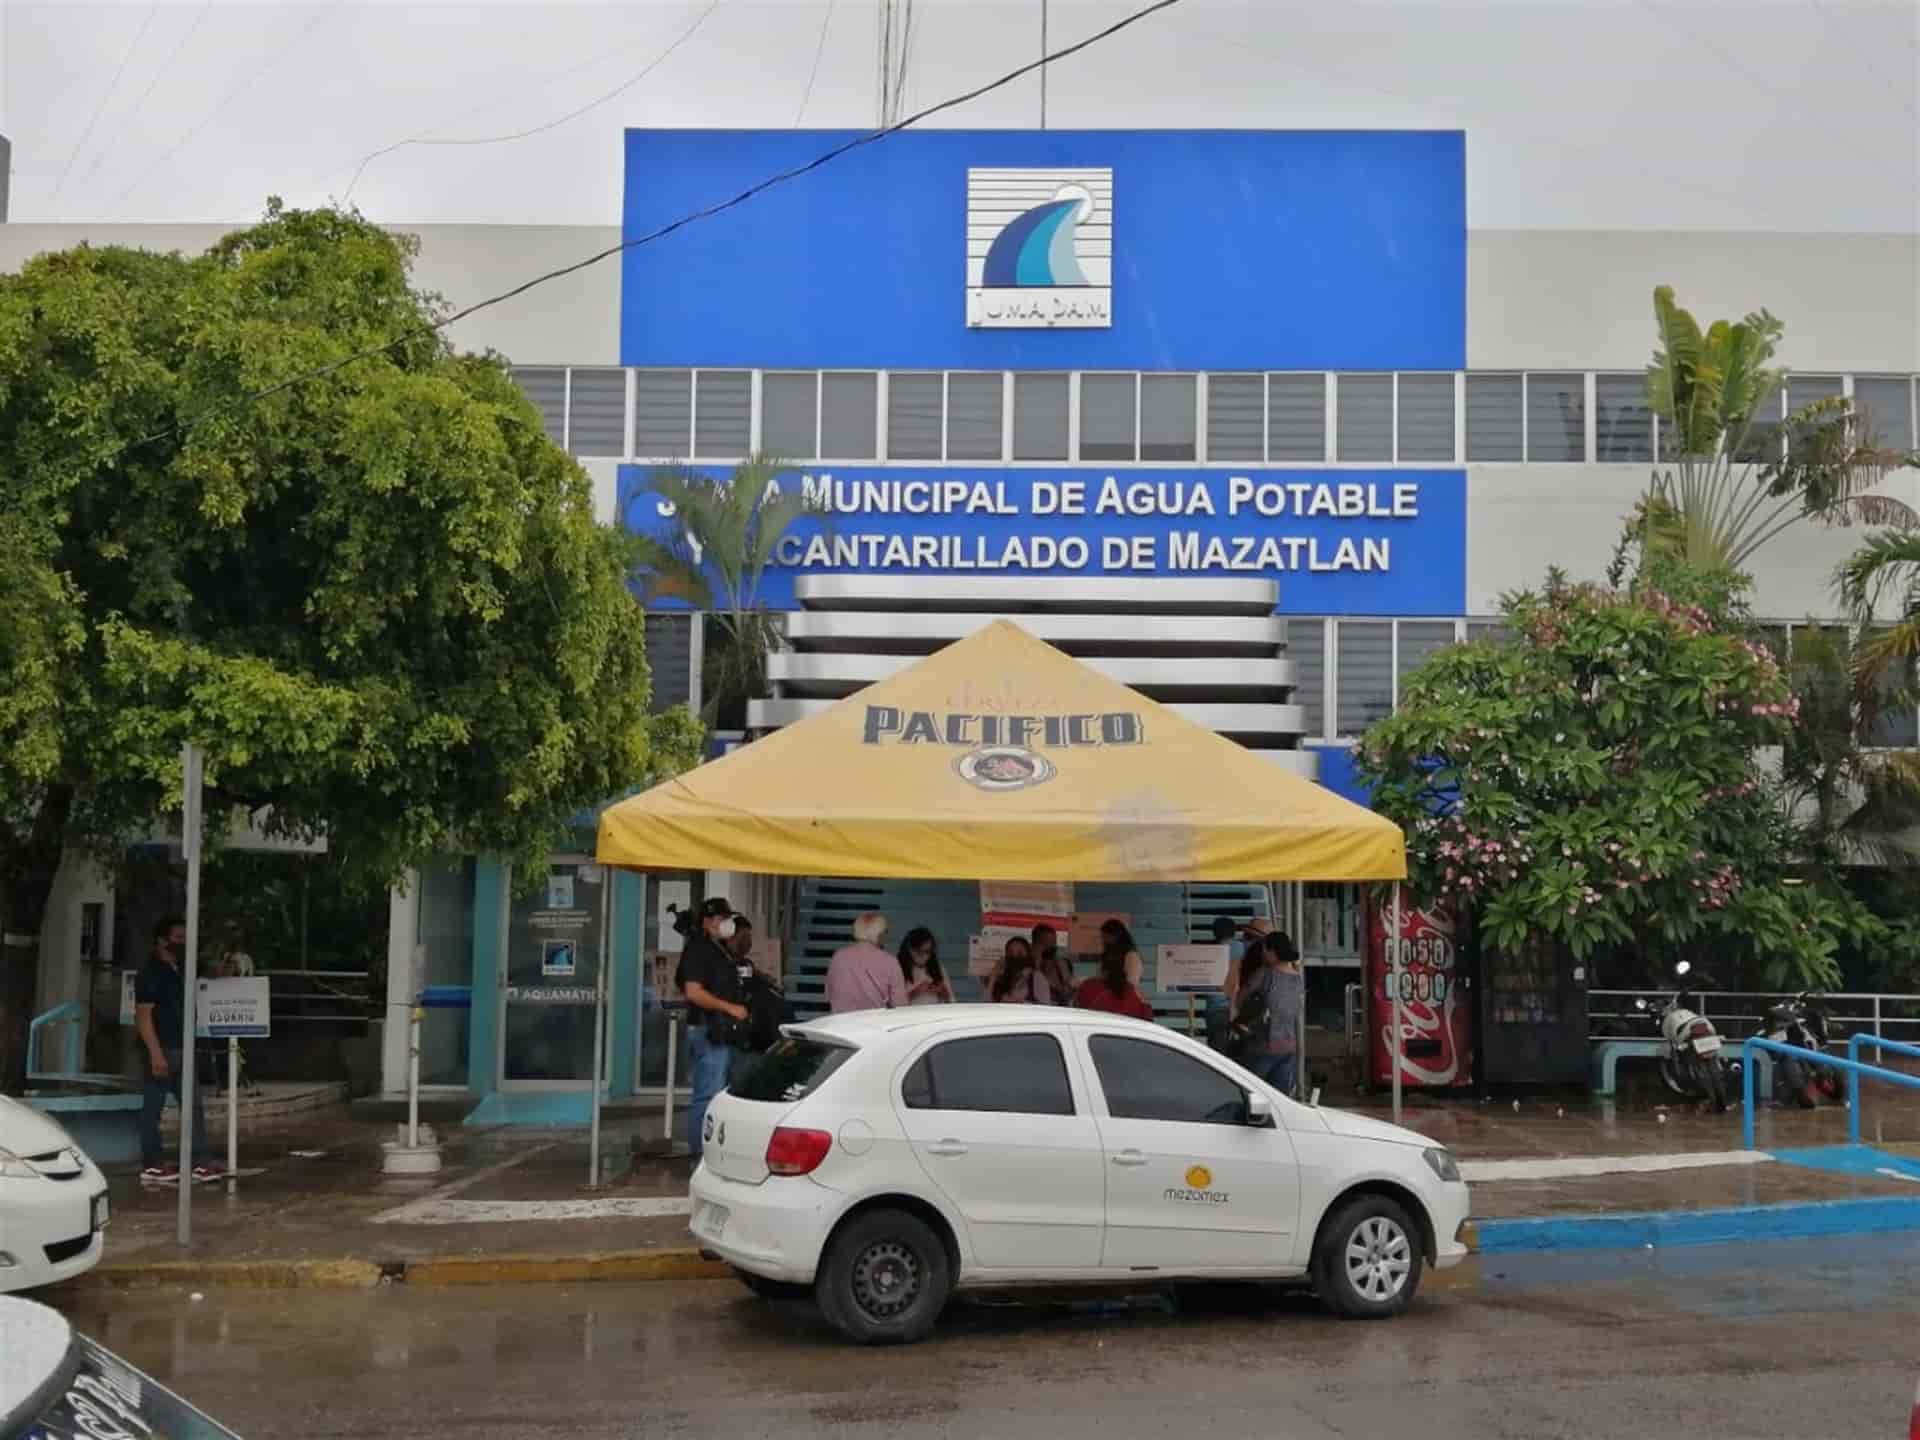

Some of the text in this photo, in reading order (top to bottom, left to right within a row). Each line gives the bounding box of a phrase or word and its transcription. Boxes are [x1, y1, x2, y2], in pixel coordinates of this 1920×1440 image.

[802, 475, 1018, 513] MUNICIPAL
[1032, 482, 1085, 515] DE
[1096, 477, 1215, 516] AGUA
[1229, 477, 1418, 517] POTABLE
[744, 535, 1088, 569] CANTARILLADO
[1102, 537, 1156, 570] DE
[1169, 531, 1390, 571] MAZATLAN
[862, 704, 1144, 746] PACIFICO
